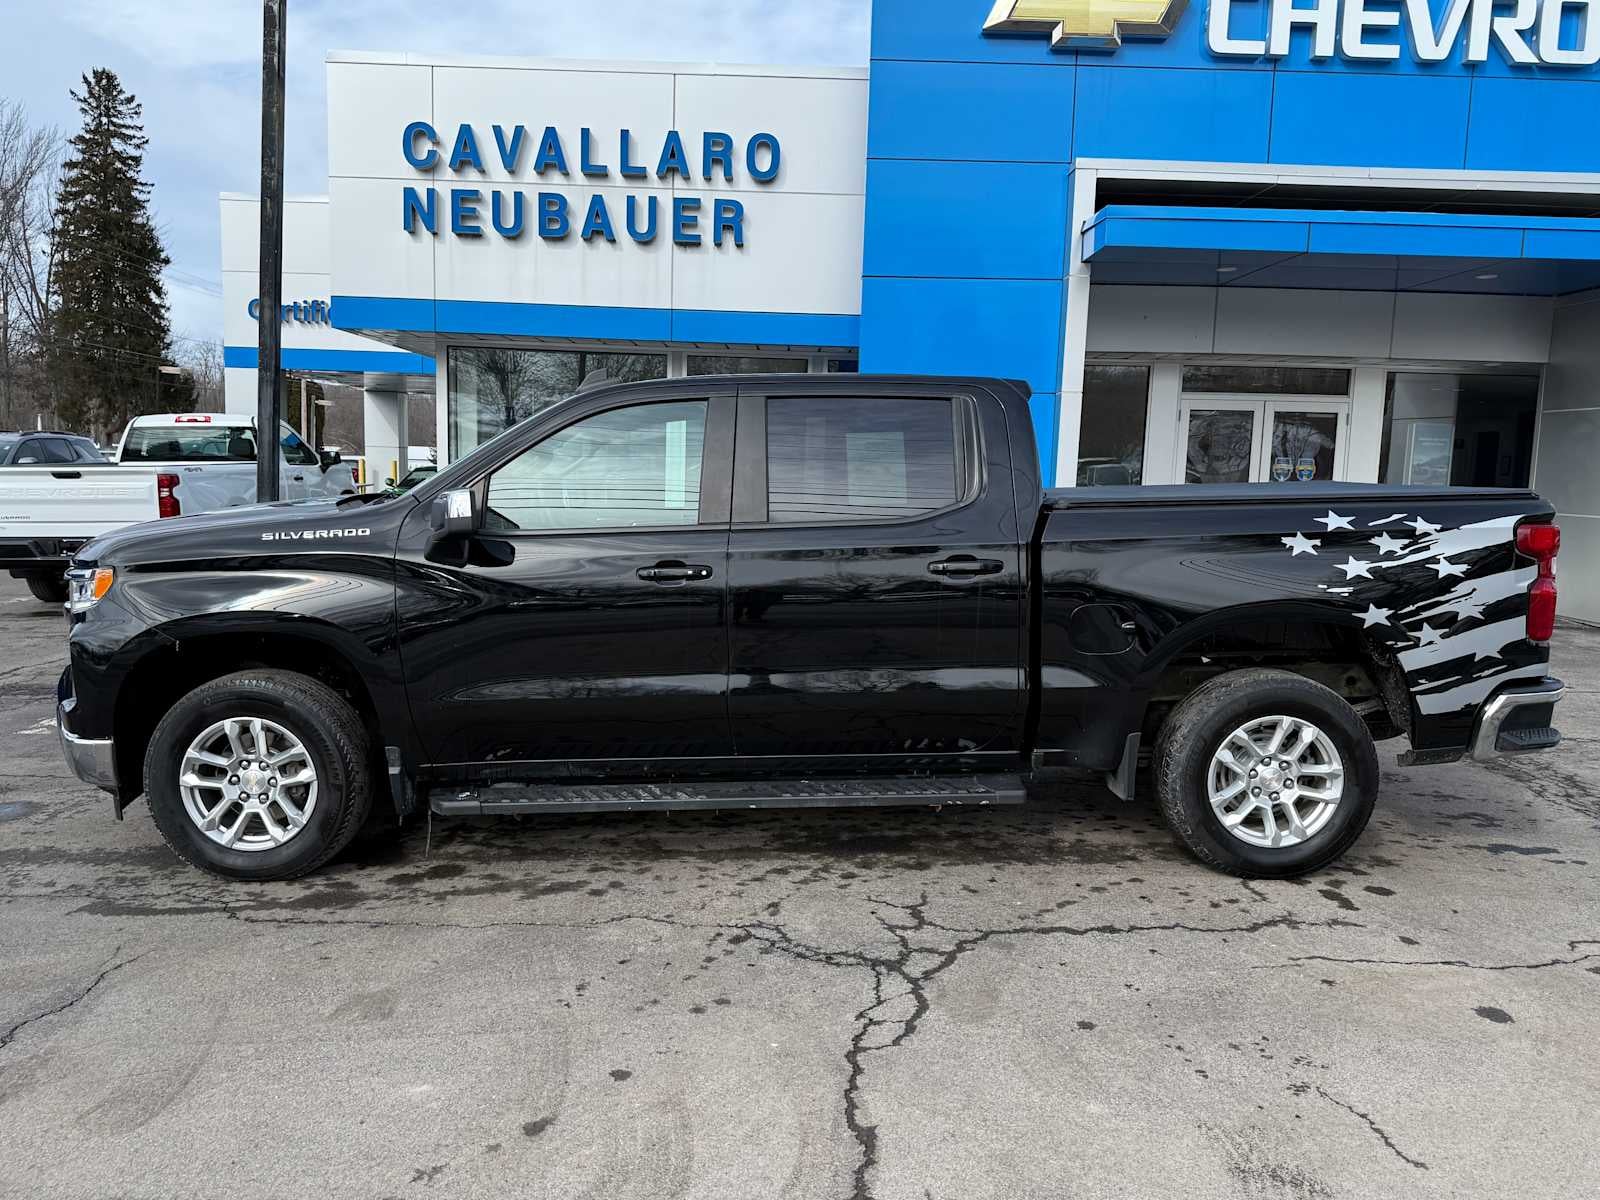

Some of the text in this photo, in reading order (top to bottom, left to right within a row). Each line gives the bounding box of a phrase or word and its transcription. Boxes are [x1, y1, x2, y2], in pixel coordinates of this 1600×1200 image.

[402, 121, 781, 183] CAVALLARO
[403, 186, 745, 247] NEUBAUER
[261, 528, 371, 541] SILVERADO
